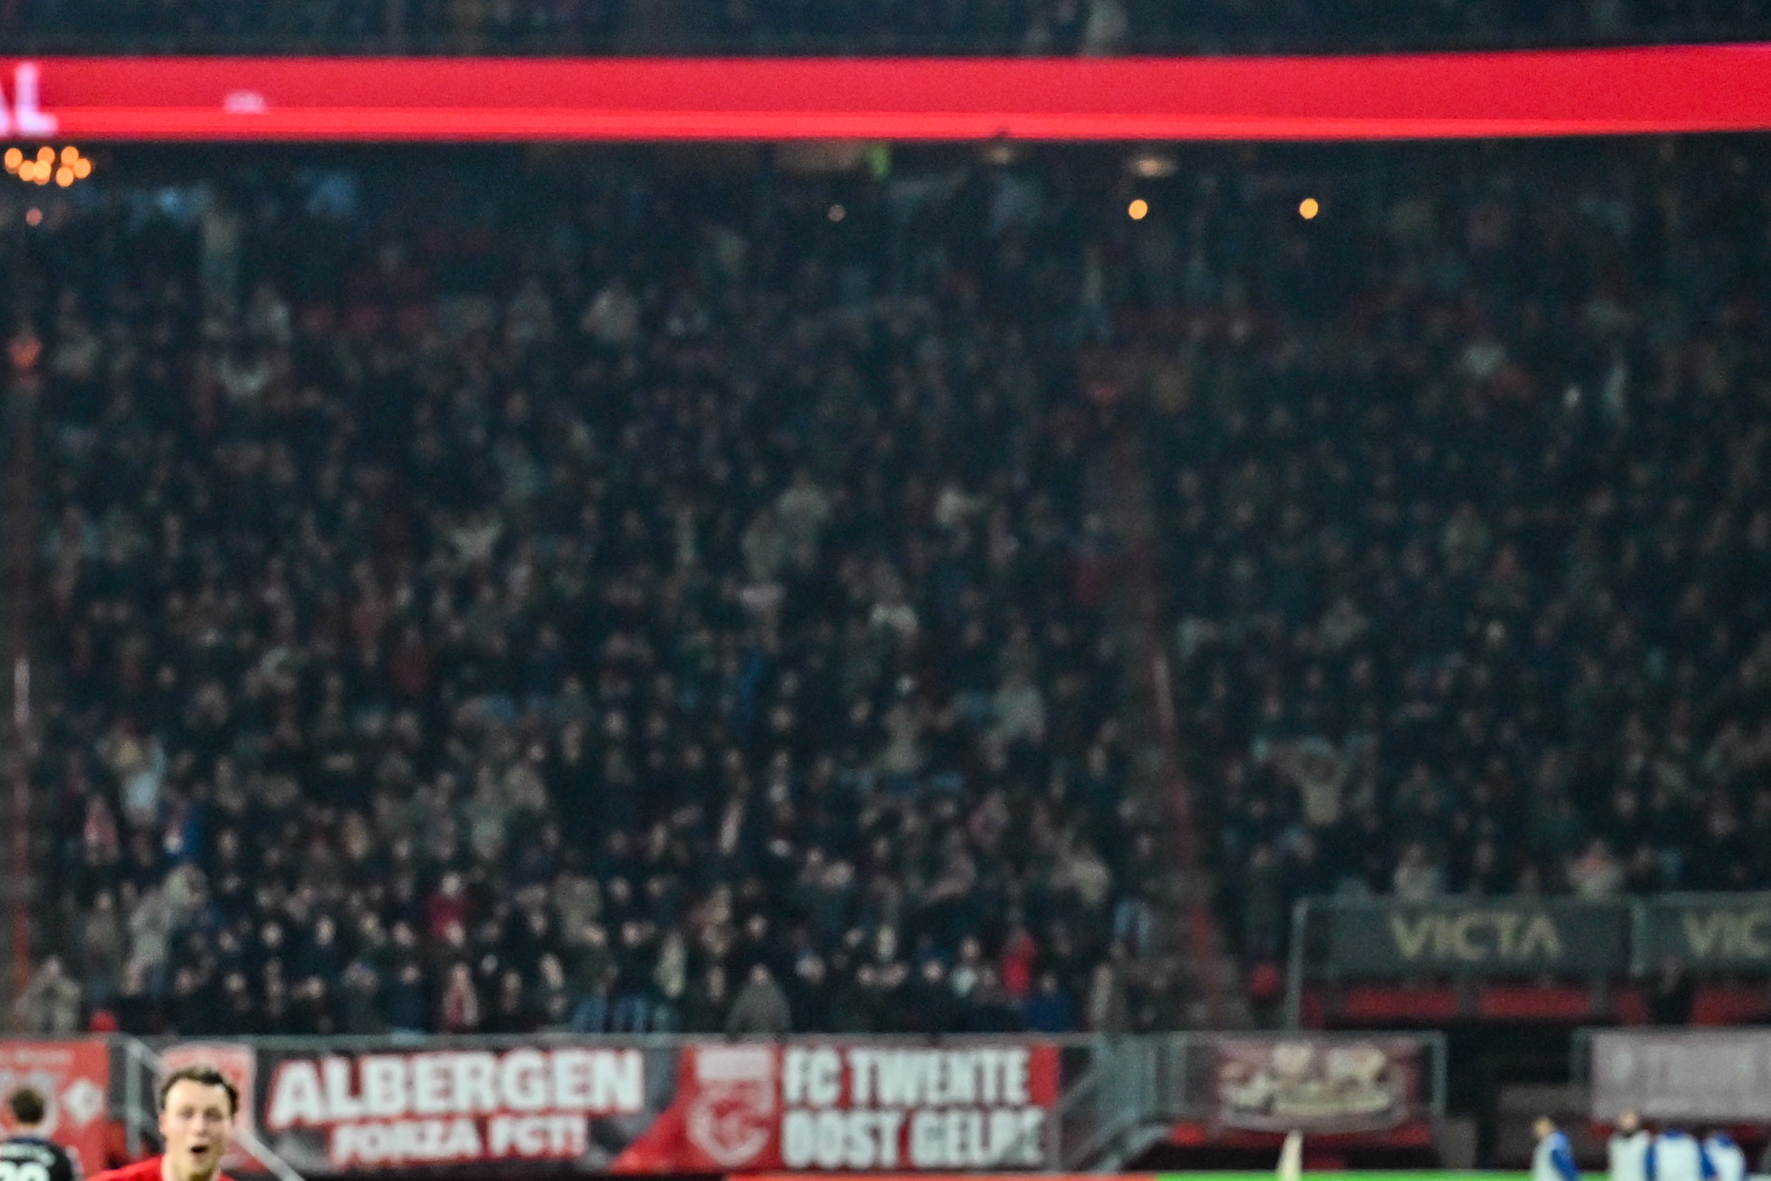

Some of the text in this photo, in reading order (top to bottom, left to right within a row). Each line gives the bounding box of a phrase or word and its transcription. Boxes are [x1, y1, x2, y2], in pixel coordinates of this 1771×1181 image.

[1391, 911, 1562, 959] VICTA
[268, 1049, 643, 1130] ALBERGEN
[781, 1048, 1029, 1104] FC TWENTE
[332, 1121, 480, 1167] FORZA
